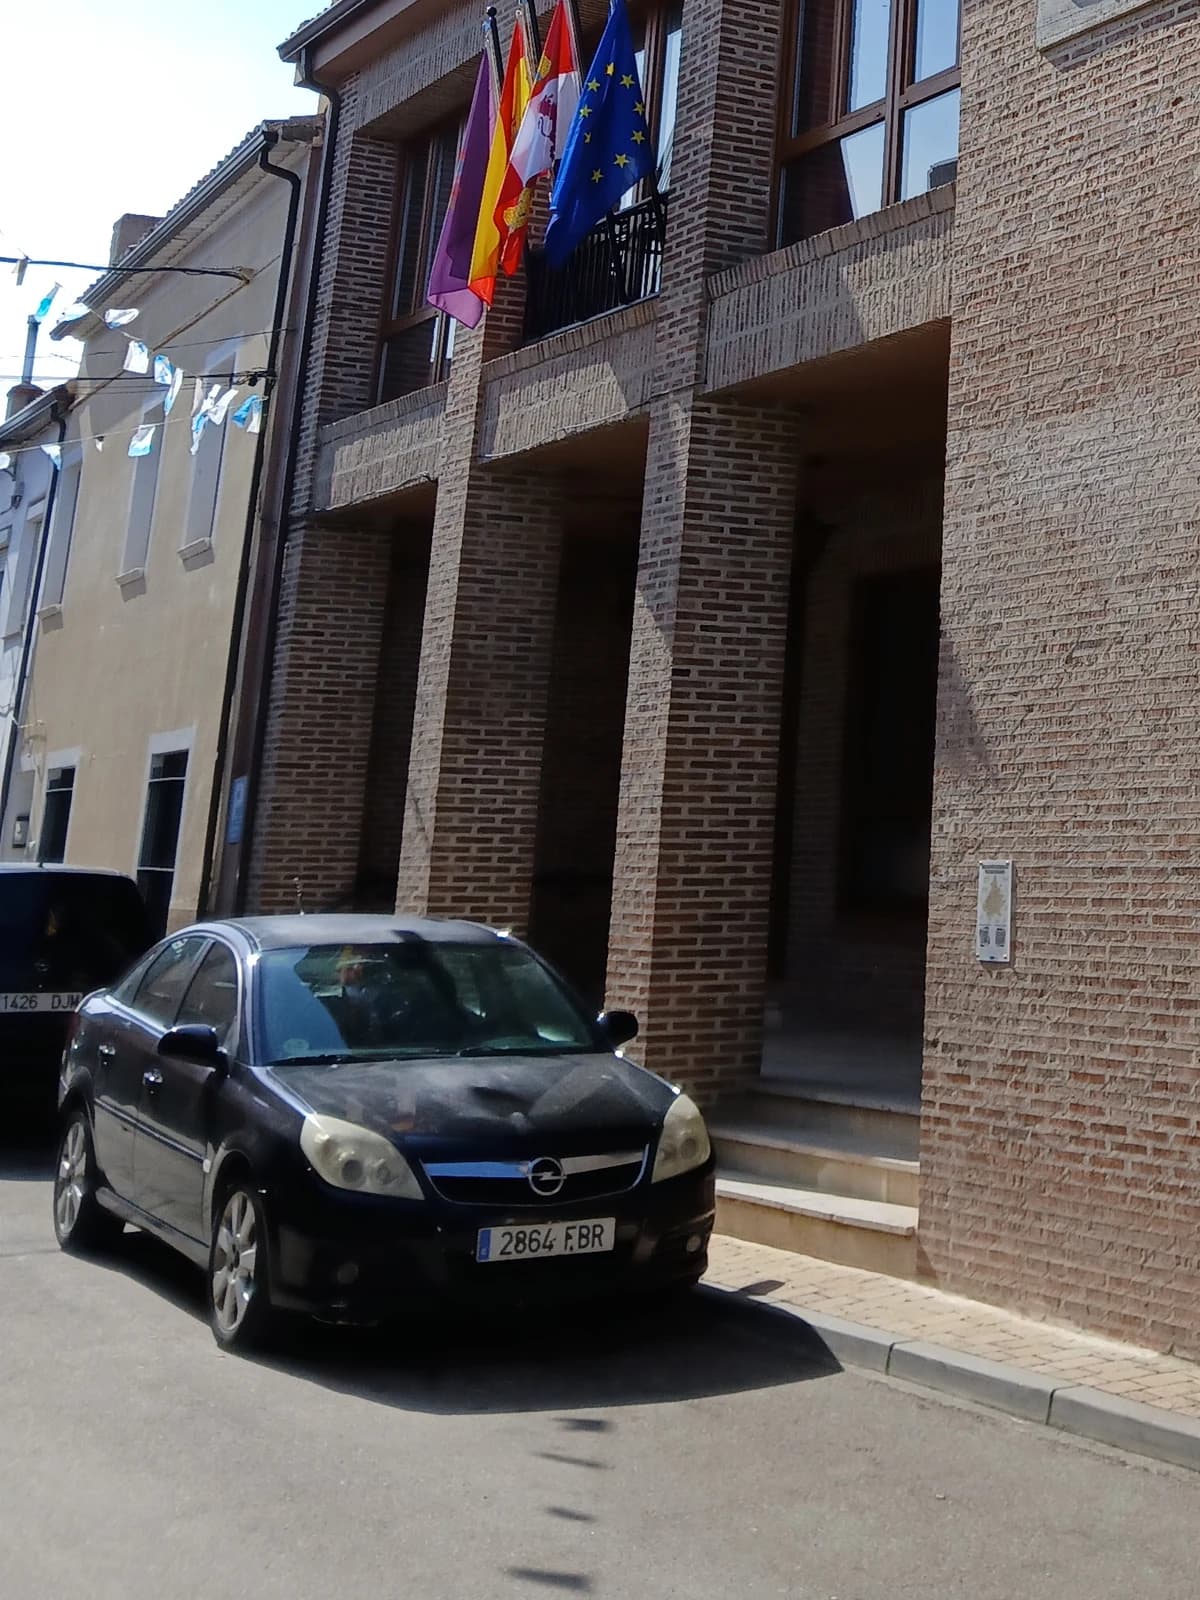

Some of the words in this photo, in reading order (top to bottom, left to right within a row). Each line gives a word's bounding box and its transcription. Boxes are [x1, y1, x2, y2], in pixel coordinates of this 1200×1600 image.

[4, 994, 38, 1010] 1426
[51, 993, 80, 1010] DJM
[499, 1228, 556, 1256] 2864
[564, 1223, 605, 1252] FBR
